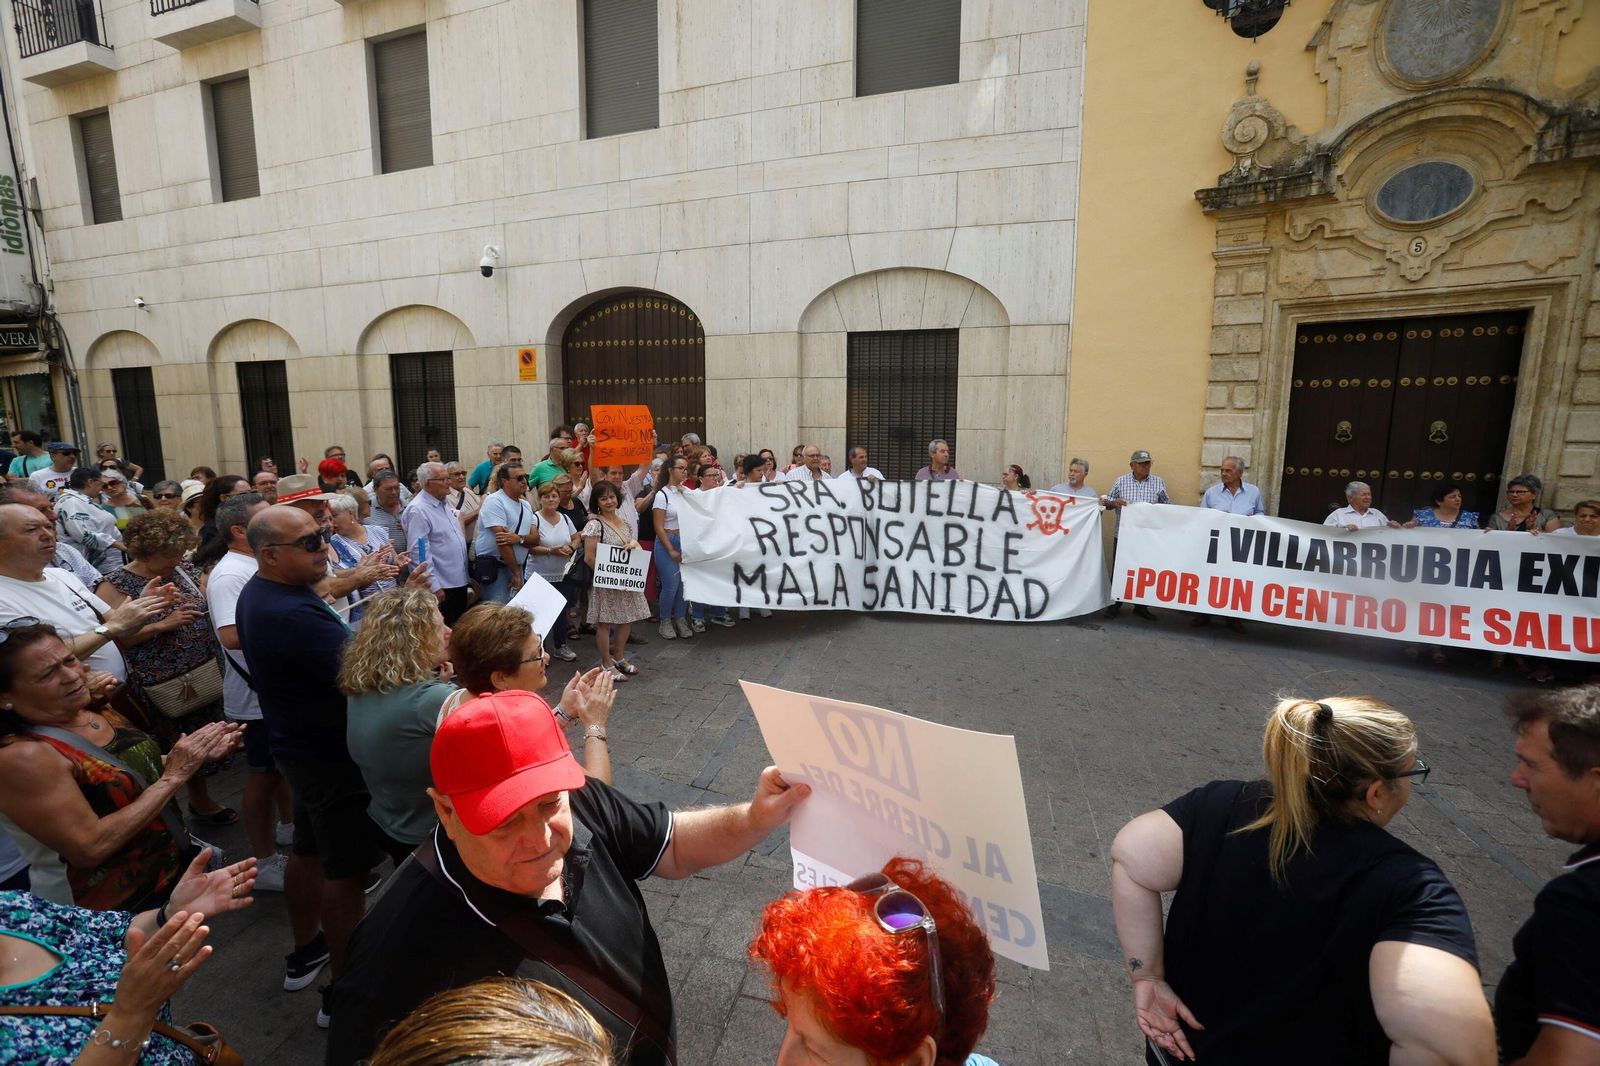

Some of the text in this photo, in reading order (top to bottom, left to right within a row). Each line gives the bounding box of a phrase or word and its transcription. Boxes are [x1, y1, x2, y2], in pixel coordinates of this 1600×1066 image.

[0, 175, 24, 254] idiomas
[1414, 242, 1422, 253] 5
[0, 332, 36, 345] VERA
[598, 427, 638, 442] SALUD
[598, 447, 615, 459] SE
[758, 477, 1019, 525] SRA. BOTELLA
[749, 512, 1024, 575] RESPONSABLE
[611, 548, 629, 563] NO
[1230, 526, 1504, 591] VILLARRUBIA
[597, 563, 643, 577] AL CIERRE DEL
[594, 575, 645, 589] CENTRO MÉDICO
[733, 561, 1050, 620] MALA SANIDAD
[1123, 567, 1200, 606] ¡POR
[1207, 575, 1254, 613] UN
[1261, 583, 1407, 634] CENTRO
[1418, 602, 1471, 641] DE
